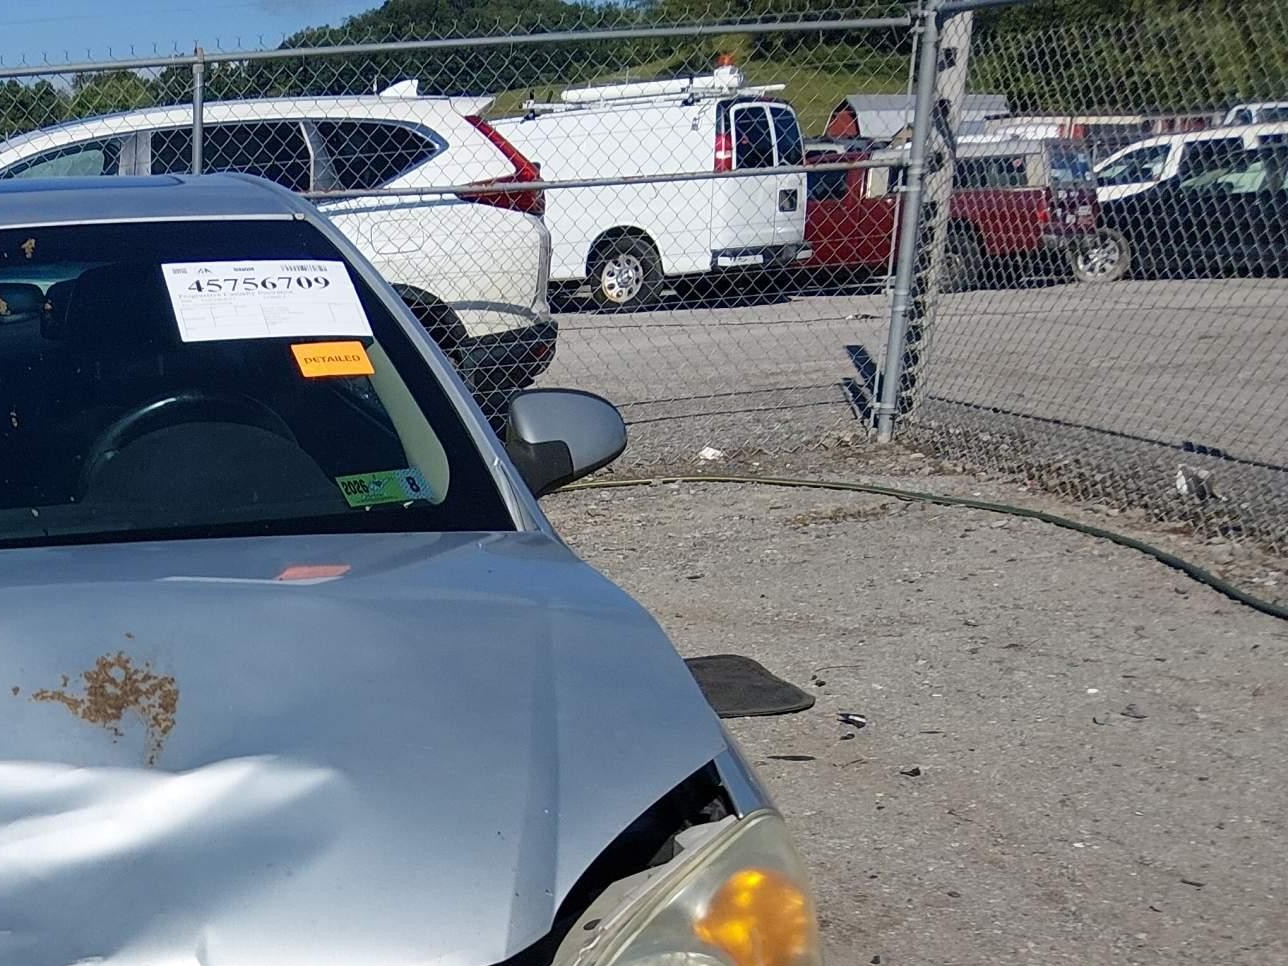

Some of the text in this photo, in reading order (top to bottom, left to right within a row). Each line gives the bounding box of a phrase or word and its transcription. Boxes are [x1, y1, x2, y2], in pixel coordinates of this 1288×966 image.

[188, 276, 330, 293] 45756709
[304, 354, 361, 365] DETAILED
[341, 479, 370, 496] 2026
